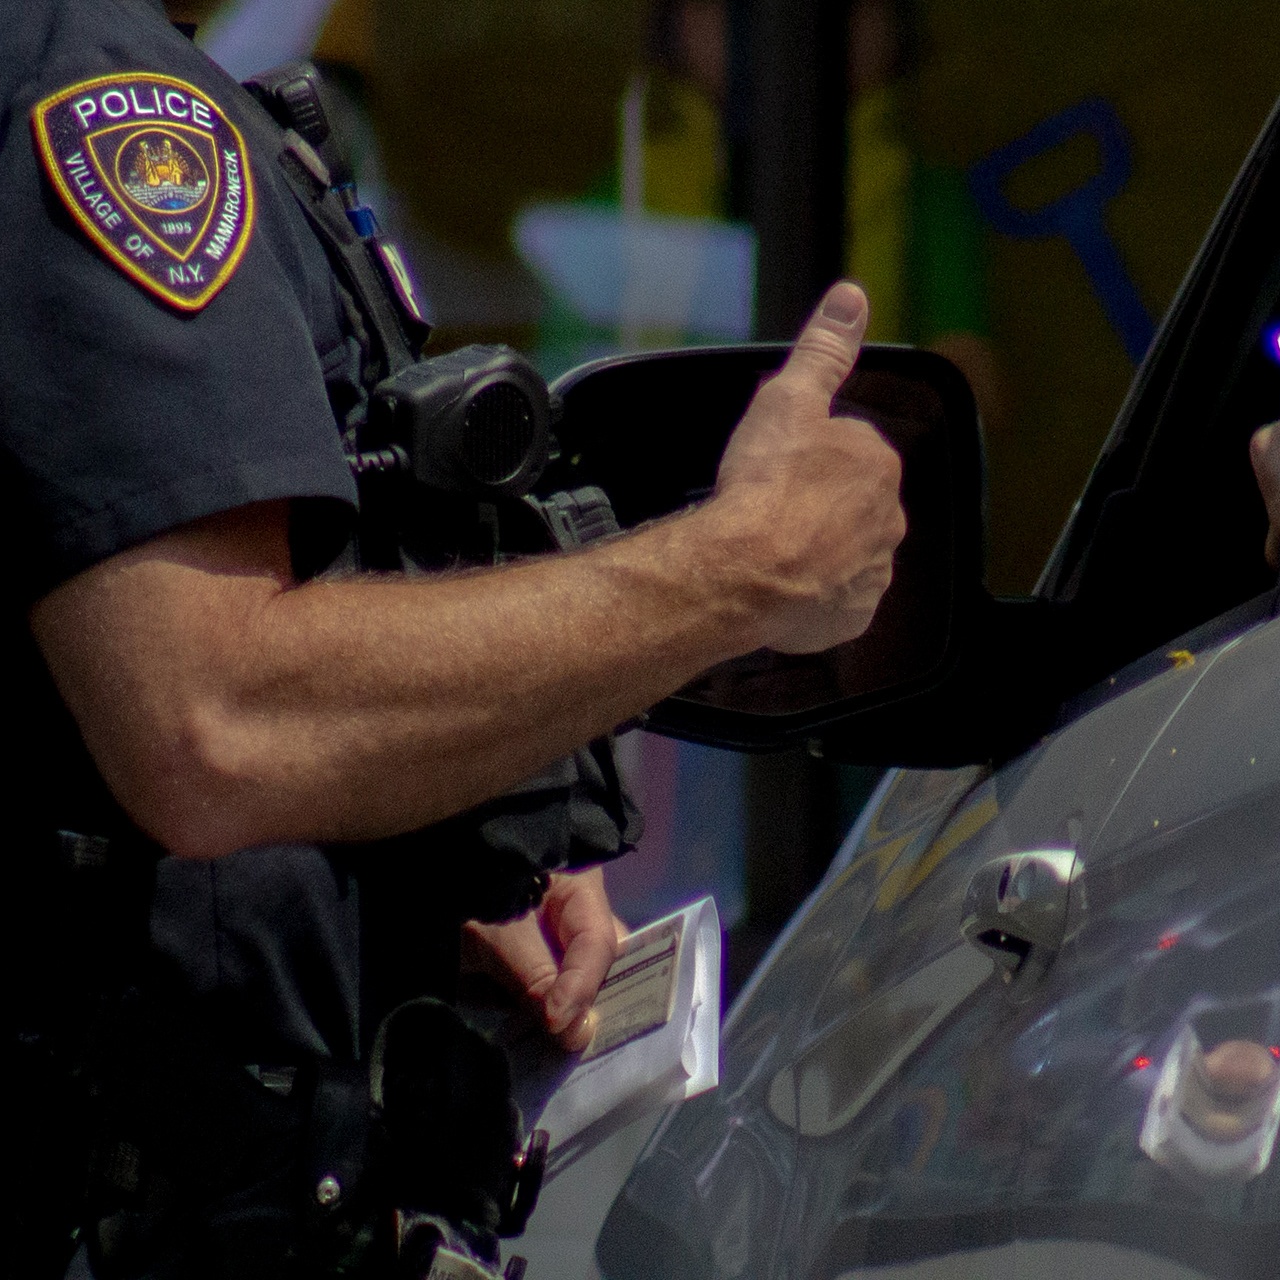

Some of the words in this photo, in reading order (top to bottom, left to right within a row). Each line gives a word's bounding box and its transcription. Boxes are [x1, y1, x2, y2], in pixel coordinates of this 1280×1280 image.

[74, 86, 213, 129] POLICE
[65, 150, 123, 230] VILLAGE
[124, 233, 155, 260] OF
[204, 148, 242, 261] MAMARONECK
[160, 220, 193, 235] 1895
[168, 262, 206, 285] N.Y.
